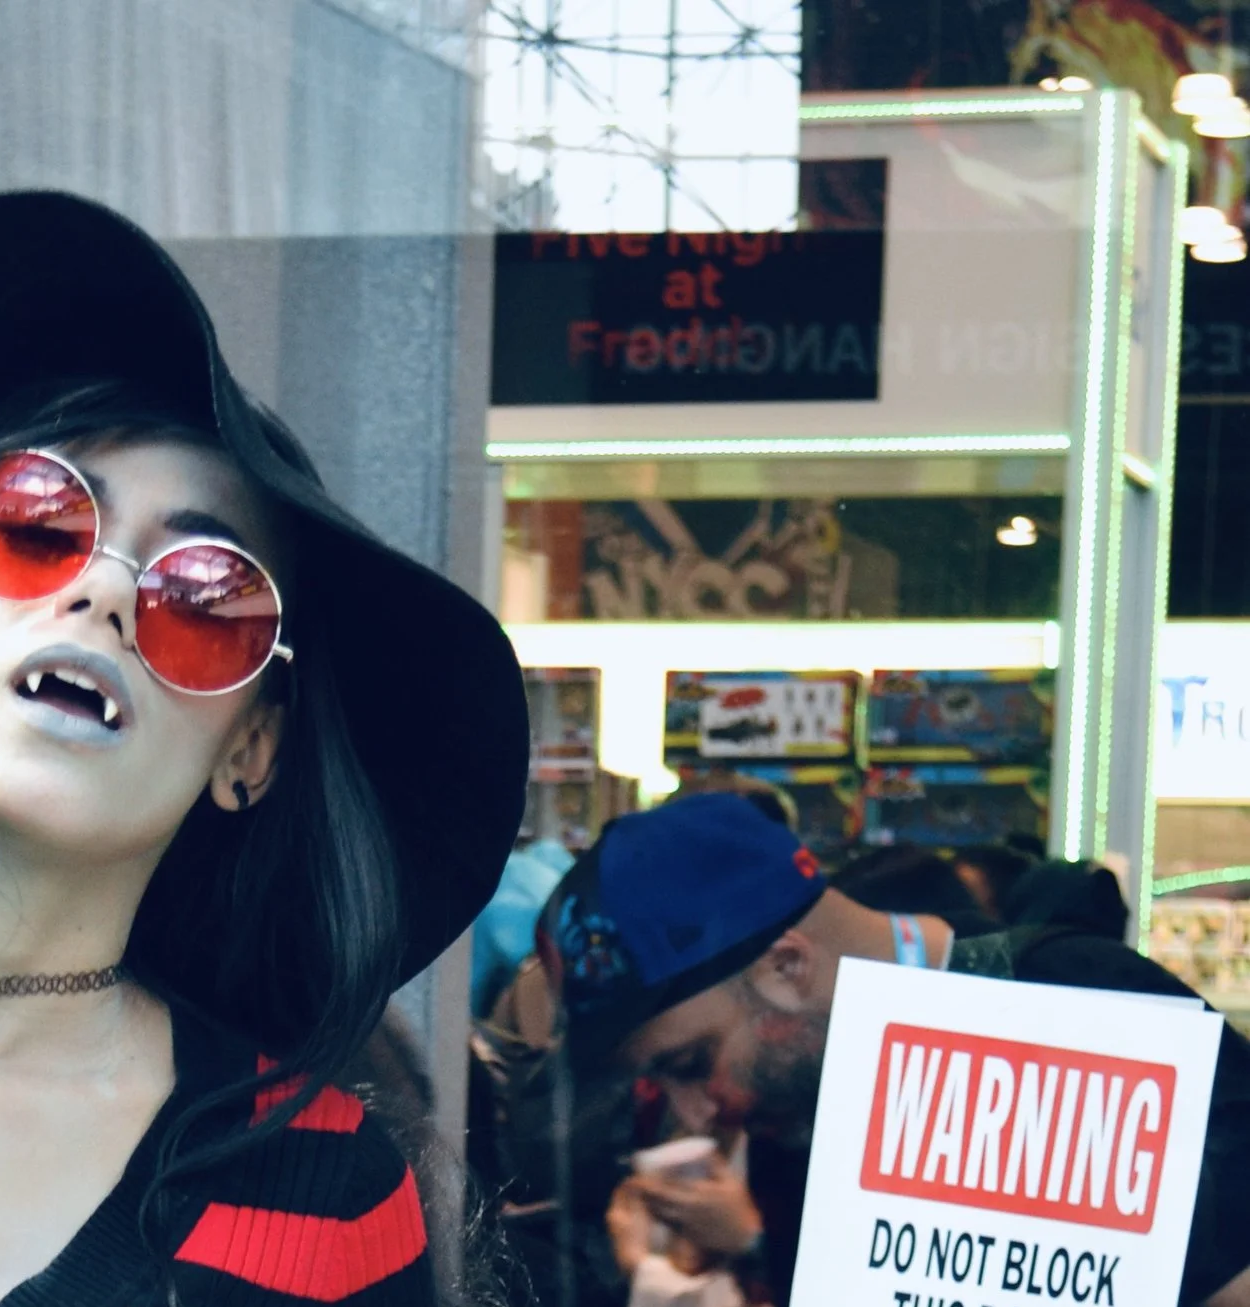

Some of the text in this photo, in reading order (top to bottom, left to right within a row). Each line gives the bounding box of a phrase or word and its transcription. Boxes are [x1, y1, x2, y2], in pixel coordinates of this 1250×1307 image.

[662, 263, 724, 310] at
[878, 1041, 1161, 1216] WARNING
[868, 1218, 1121, 1307] DO NOT BLOCK
